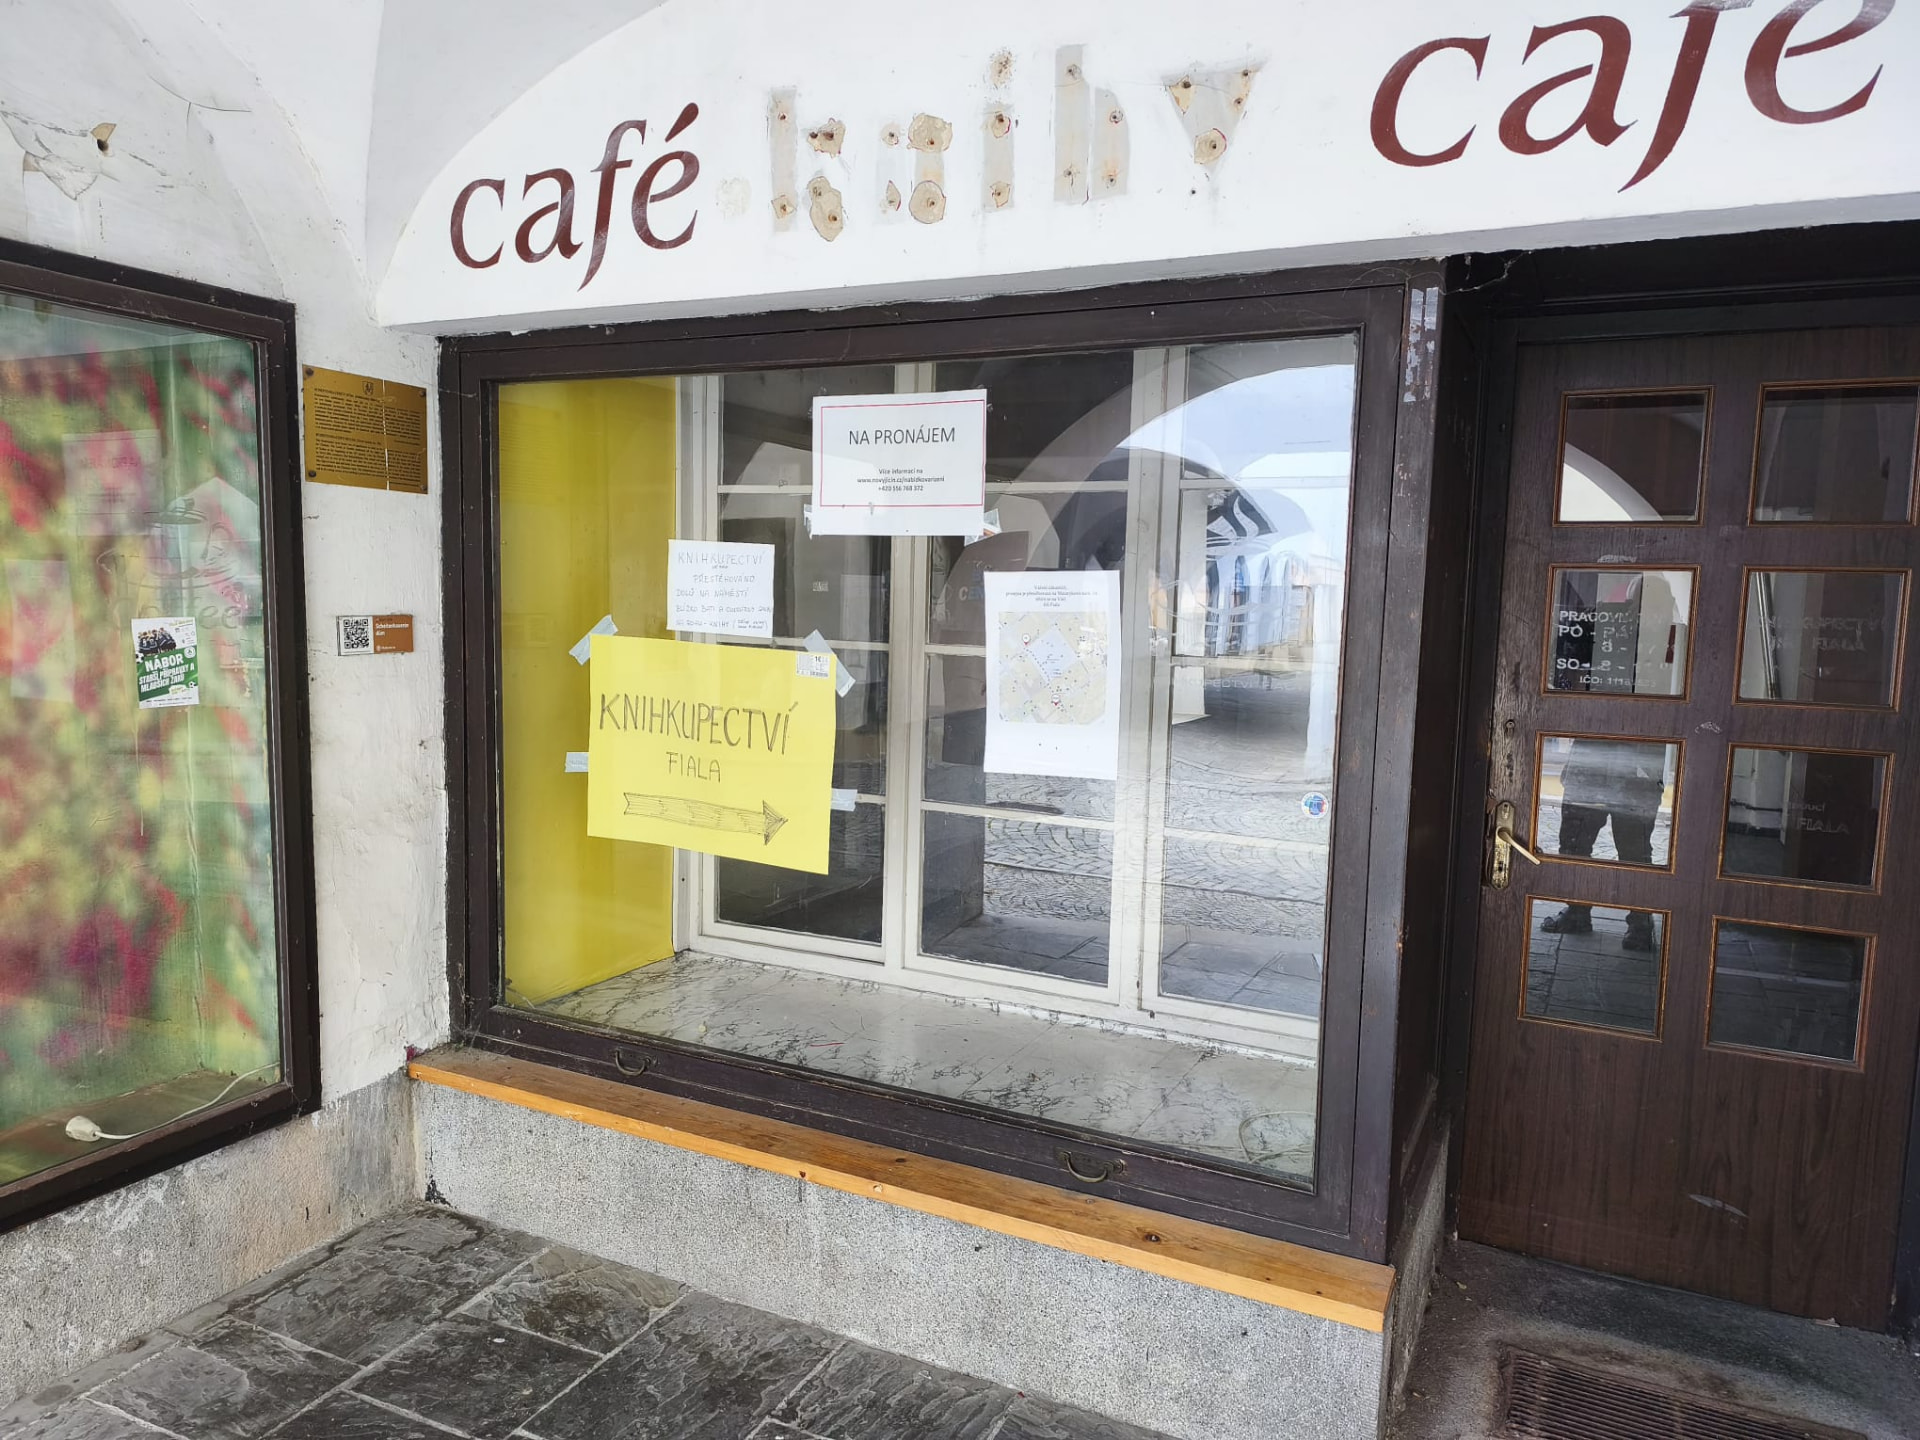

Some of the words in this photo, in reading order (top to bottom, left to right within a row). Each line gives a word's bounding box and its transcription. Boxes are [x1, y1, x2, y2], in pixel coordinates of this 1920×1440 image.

[450, 102, 700, 291] café
[849, 430, 870, 445] NA
[874, 424, 956, 445] PRONÁJEM
[892, 467, 916, 475] informací
[678, 551, 764, 565] KNIHKUPECTVÍ
[1557, 623, 1584, 638] PO
[144, 653, 185, 673] NÁBOR
[190, 662, 195, 671] A
[1556, 657, 1580, 670] SO
[600, 693, 798, 755] KNIHKUPECTVÍ
[666, 751, 721, 783] FIALA
